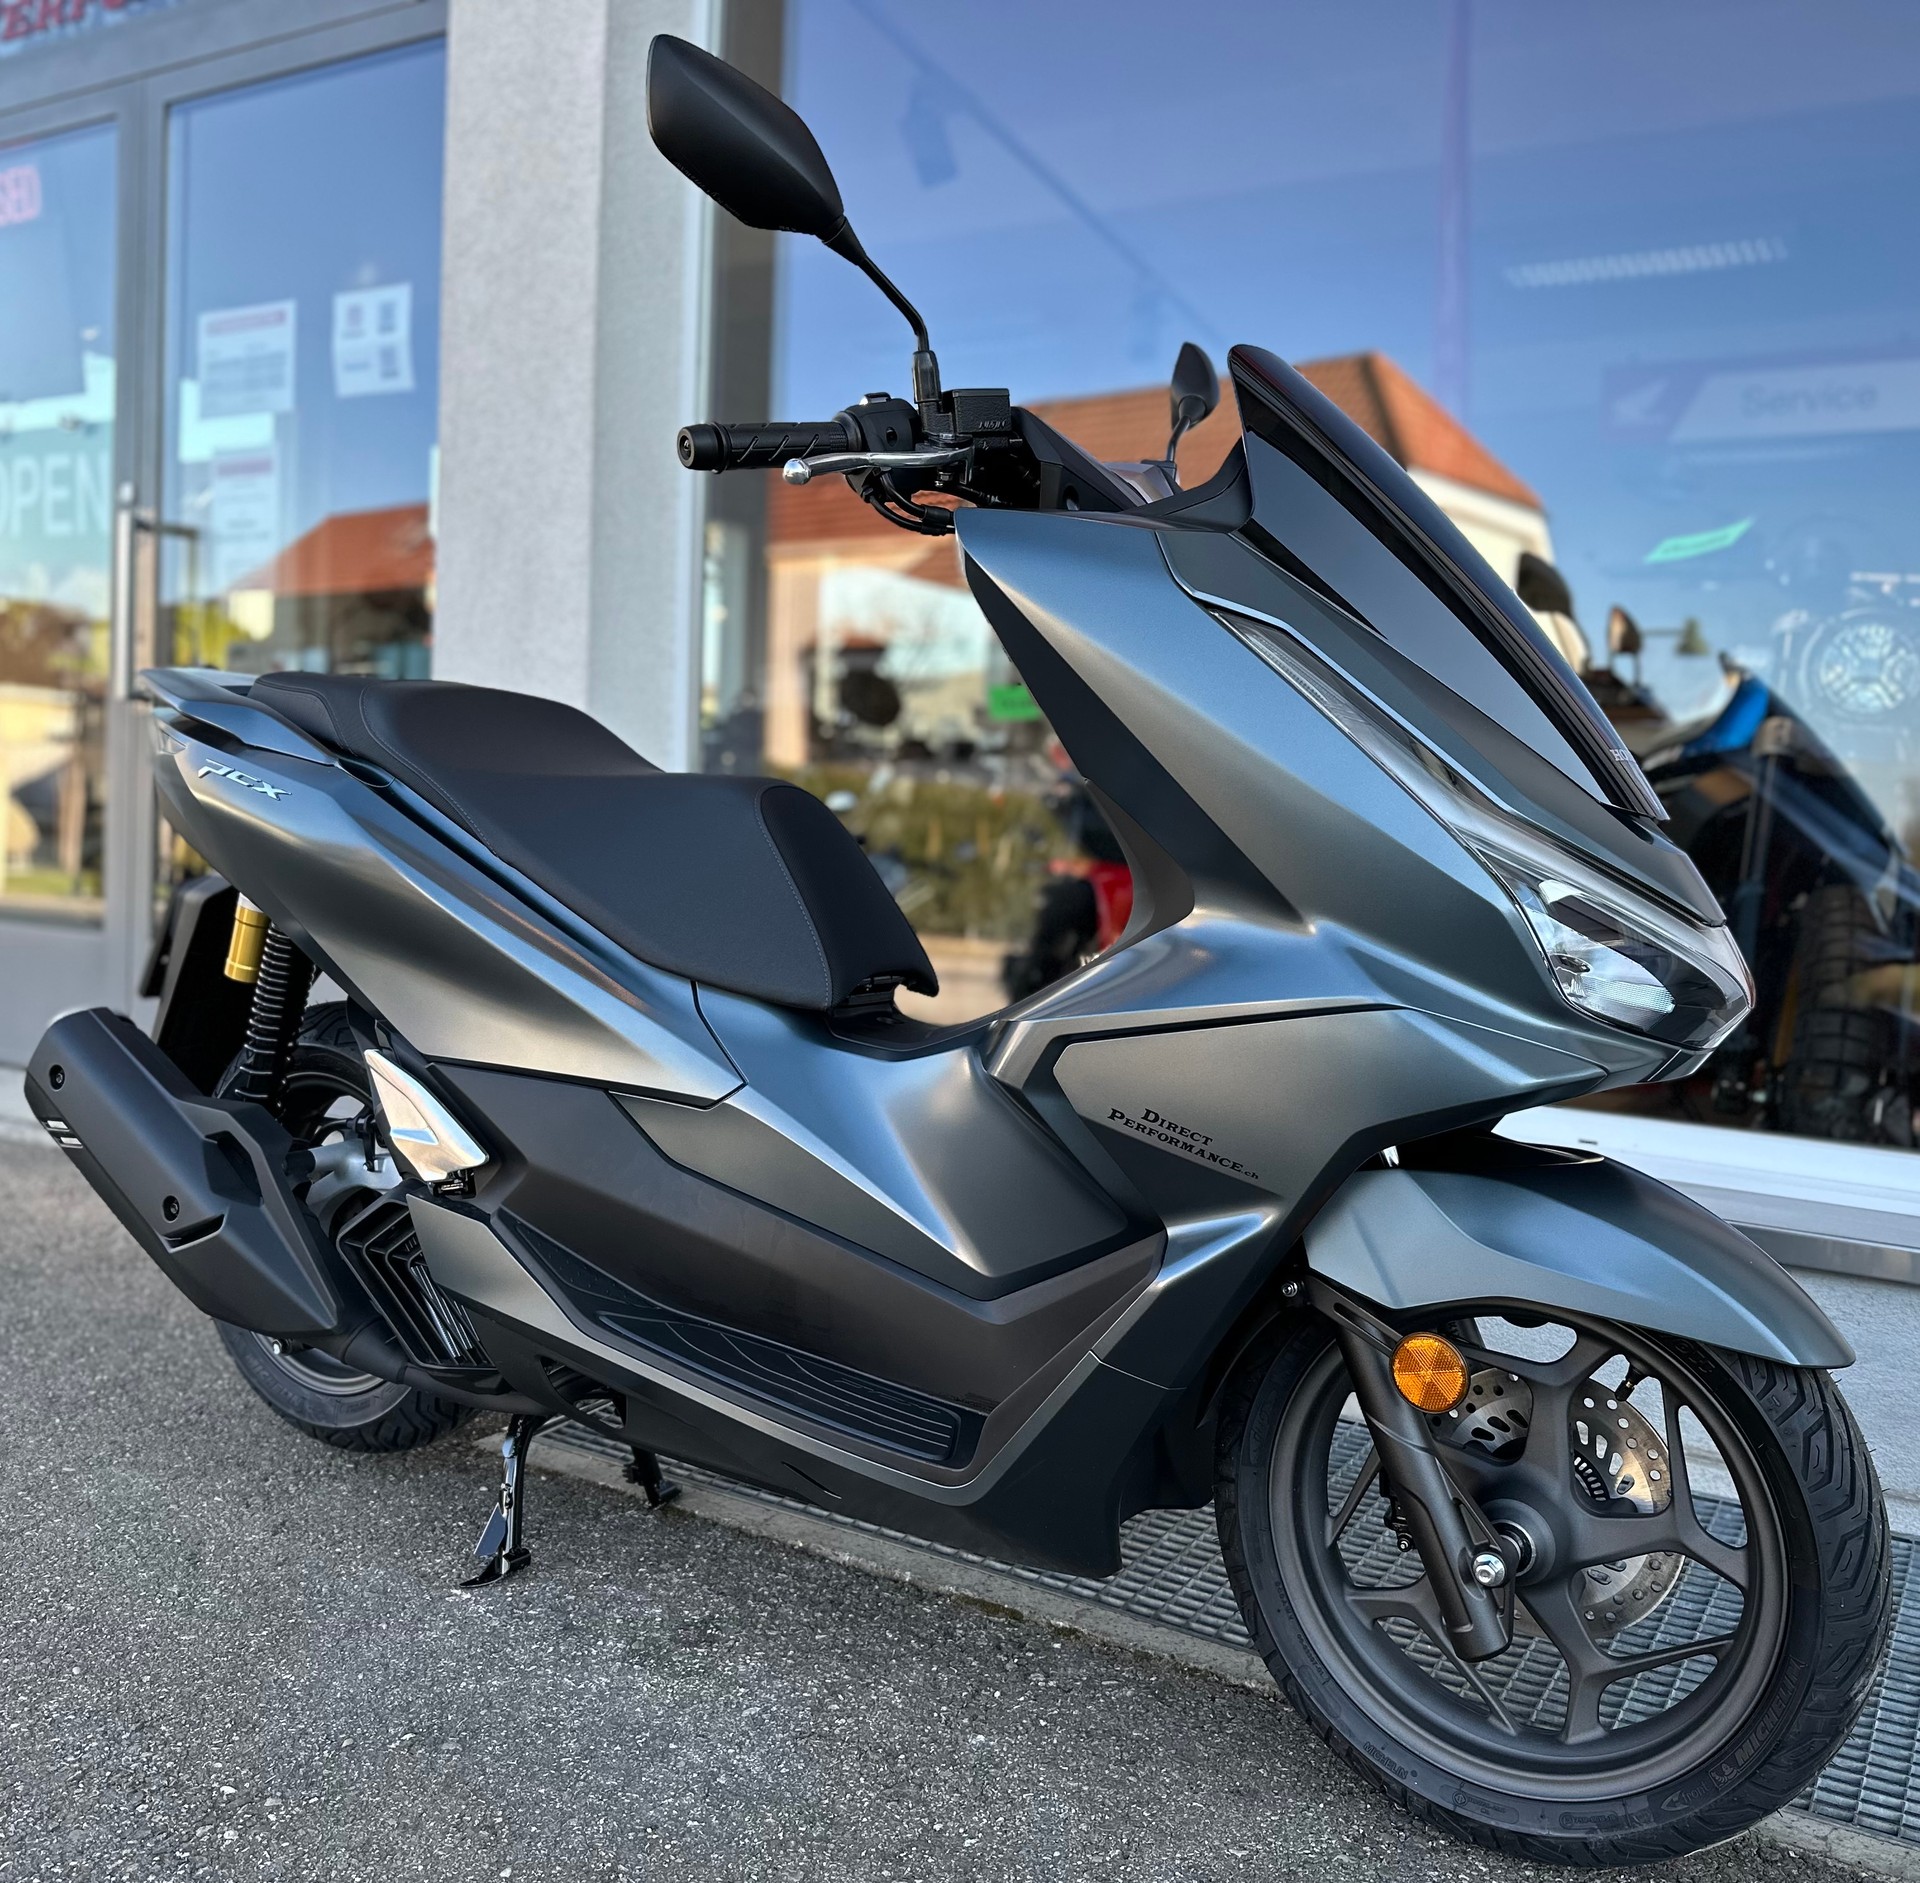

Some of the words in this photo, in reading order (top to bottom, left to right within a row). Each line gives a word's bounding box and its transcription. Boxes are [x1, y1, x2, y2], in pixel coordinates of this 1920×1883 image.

[1742, 383, 1878, 418] Service
[0, 453, 110, 539] PEN
[198, 758, 292, 801] PCX
[1141, 1107, 1214, 1146] DIRECT
[1734, 1655, 1803, 1767] MICHELIN
[1363, 1741, 1408, 1780] MICHELIN
